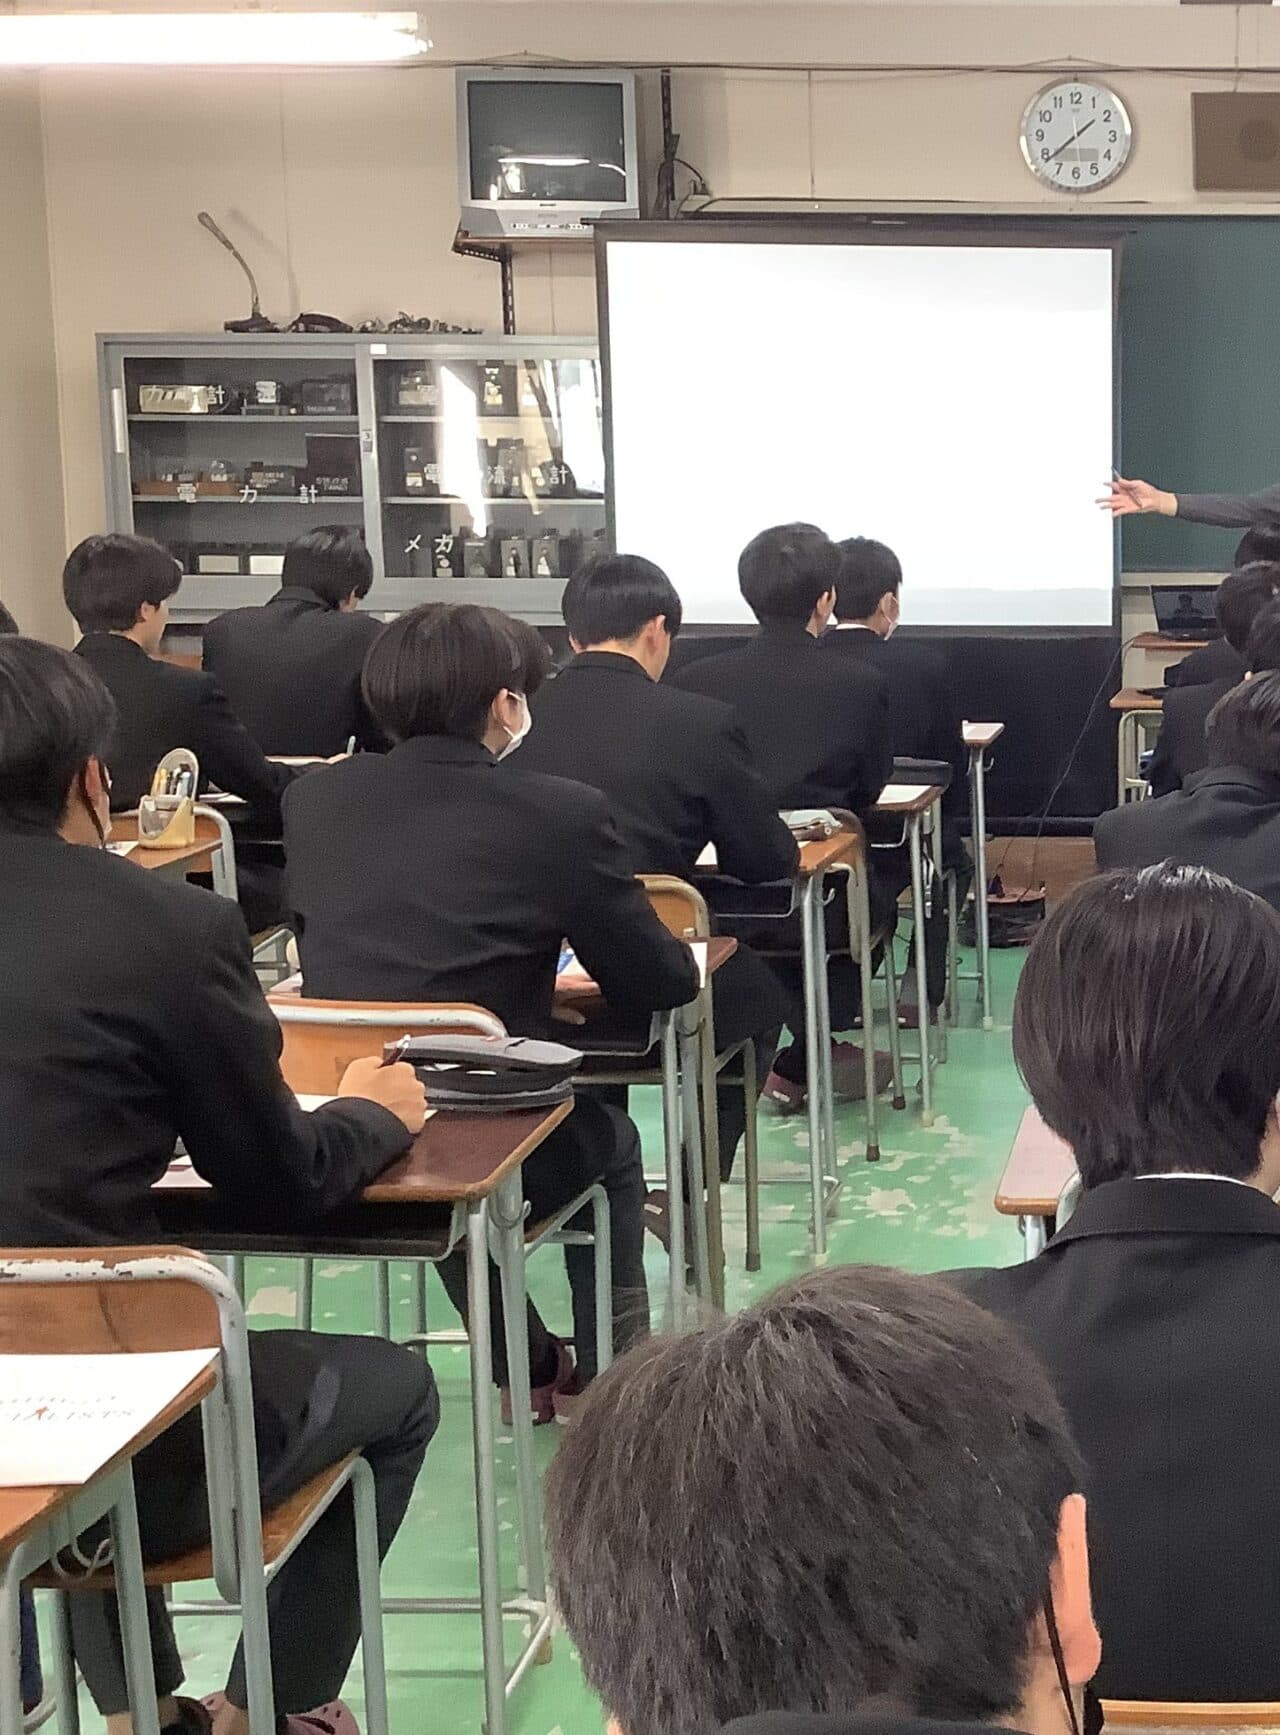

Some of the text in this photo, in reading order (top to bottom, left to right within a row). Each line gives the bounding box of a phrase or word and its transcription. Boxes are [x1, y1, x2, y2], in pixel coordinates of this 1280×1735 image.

[1053, 96, 1063, 109] 11
[1069, 91, 1082, 104] 12
[1091, 96, 1096, 109] 1
[1039, 110, 1052, 123] 10
[1103, 109, 1111, 122] 2
[1035, 129, 1045, 142] 9
[1108, 130, 1117, 143] 3
[1041, 147, 1050, 160] 8
[1103, 149, 1111, 161] 4
[1055, 162, 1063, 175] 7
[1071, 167, 1081, 180] 6
[1090, 163, 1099, 176] 5
[404, 534, 454, 553] メガ
